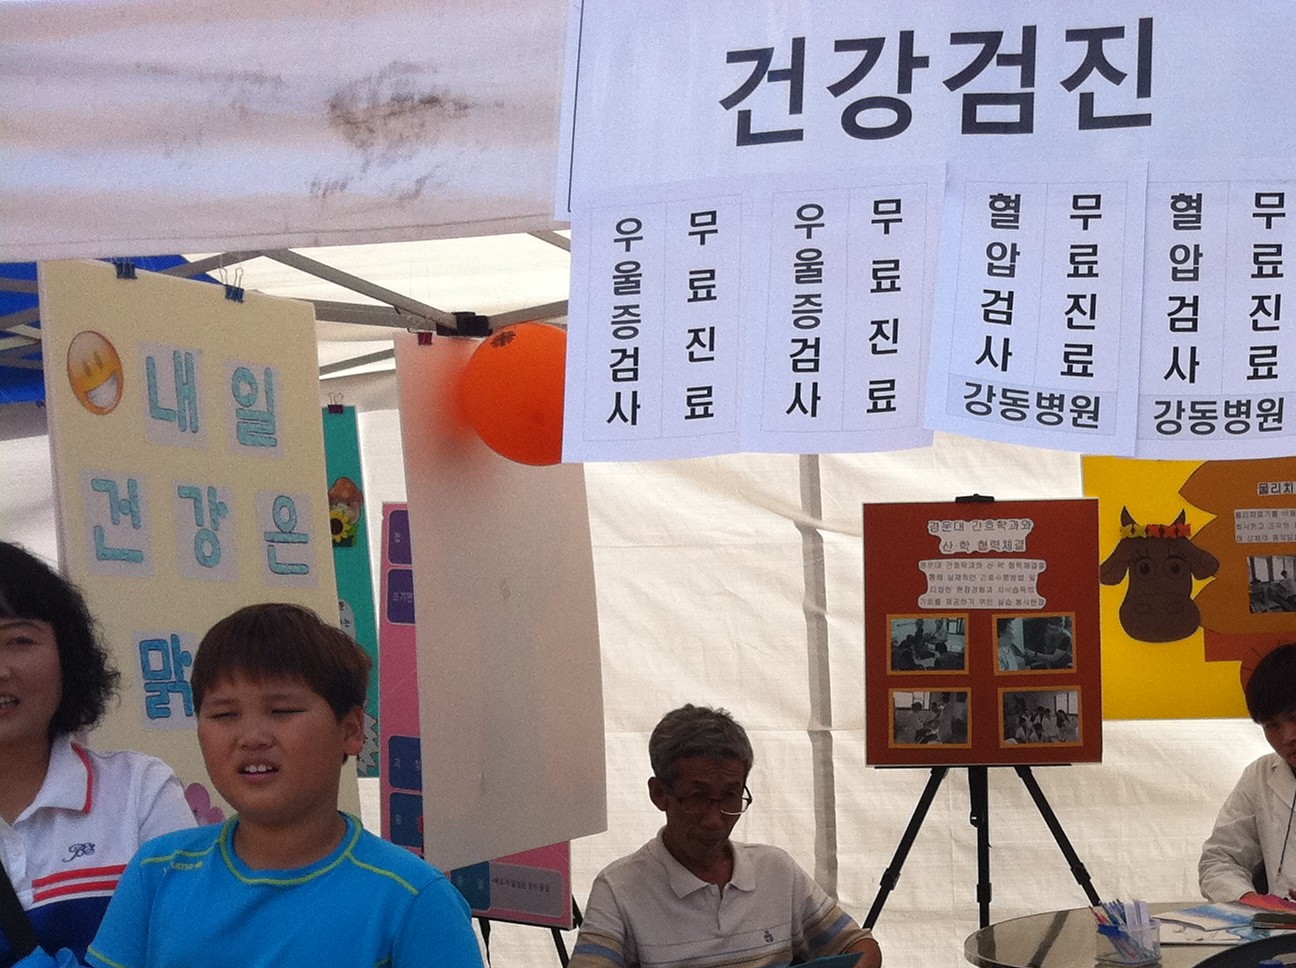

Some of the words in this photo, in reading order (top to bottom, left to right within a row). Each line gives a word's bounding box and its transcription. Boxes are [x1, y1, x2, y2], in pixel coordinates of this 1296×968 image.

[718, 16, 1155, 147] 건강검진
[605, 216, 643, 427] 우울증검사
[683, 210, 719, 421] 무료진료
[786, 202, 825, 418] 우울증검사
[866, 197, 904, 415] 무료진료
[975, 192, 1021, 373] 혈압검사
[1060, 193, 1103, 379] 무료진료
[1164, 192, 1203, 384] 혈압검사
[1246, 192, 1287, 382] 무료진료
[146, 350, 277, 449] 내일
[963, 381, 1101, 429] 강동병원
[1153, 397, 1286, 436] 강동병원
[91, 477, 310, 575] 건강은
